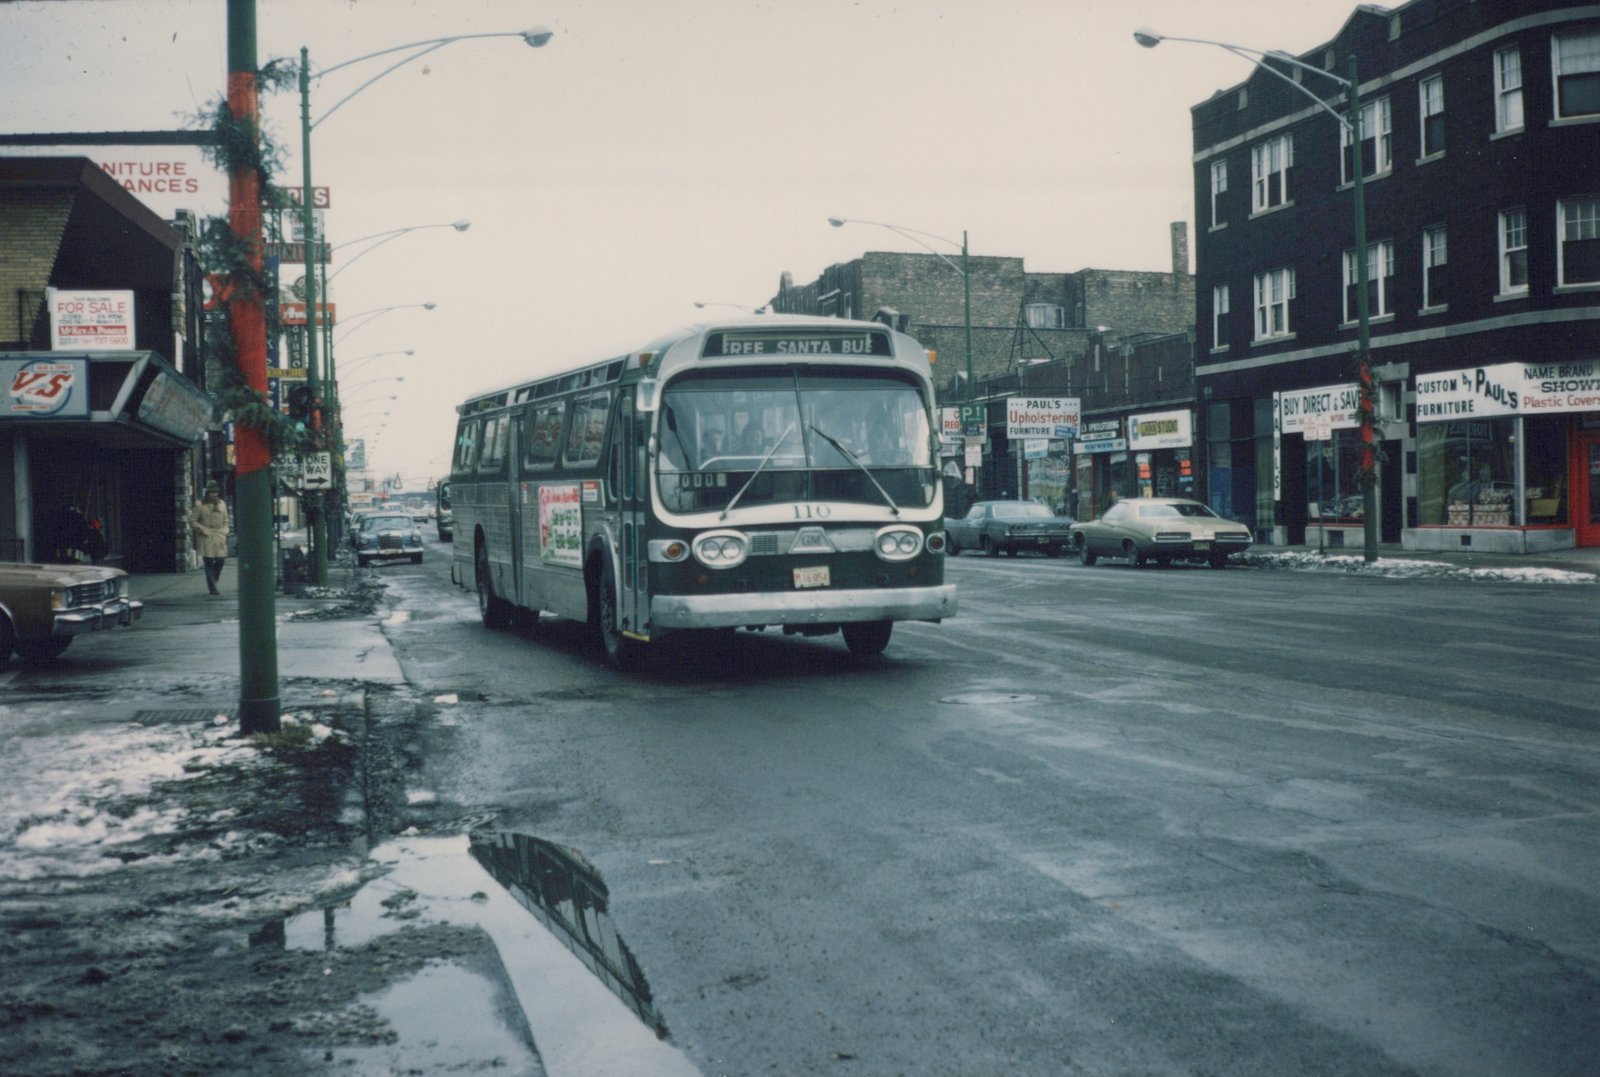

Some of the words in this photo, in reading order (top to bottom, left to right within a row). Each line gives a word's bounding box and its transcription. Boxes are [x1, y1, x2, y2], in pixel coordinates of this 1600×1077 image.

[102, 162, 187, 176] NITURE
[122, 179, 198, 193] ANCES
[57, 302, 84, 313] FOR
[88, 301, 127, 313] SALE
[776, 341, 832, 353] SANTA
[1524, 367, 1555, 380] NAME
[1558, 365, 1594, 378] BRAND
[1417, 379, 1457, 394] CUSTOM
[1462, 372, 1472, 392] by
[1475, 368, 1518, 409] PAUL'S
[1027, 400, 1061, 409] PAUL'S
[1283, 398, 1300, 416] BUY
[1303, 393, 1331, 414] DIRECT
[1417, 399, 1474, 416] FURNITURE
[1523, 395, 1562, 408] Plastic
[1009, 410, 1078, 427] Upholstering
[1009, 427, 1050, 435] FURNITURE
[306, 455, 328, 465] ONE
[306, 465, 328, 474] WAY
[794, 505, 831, 518] 110
